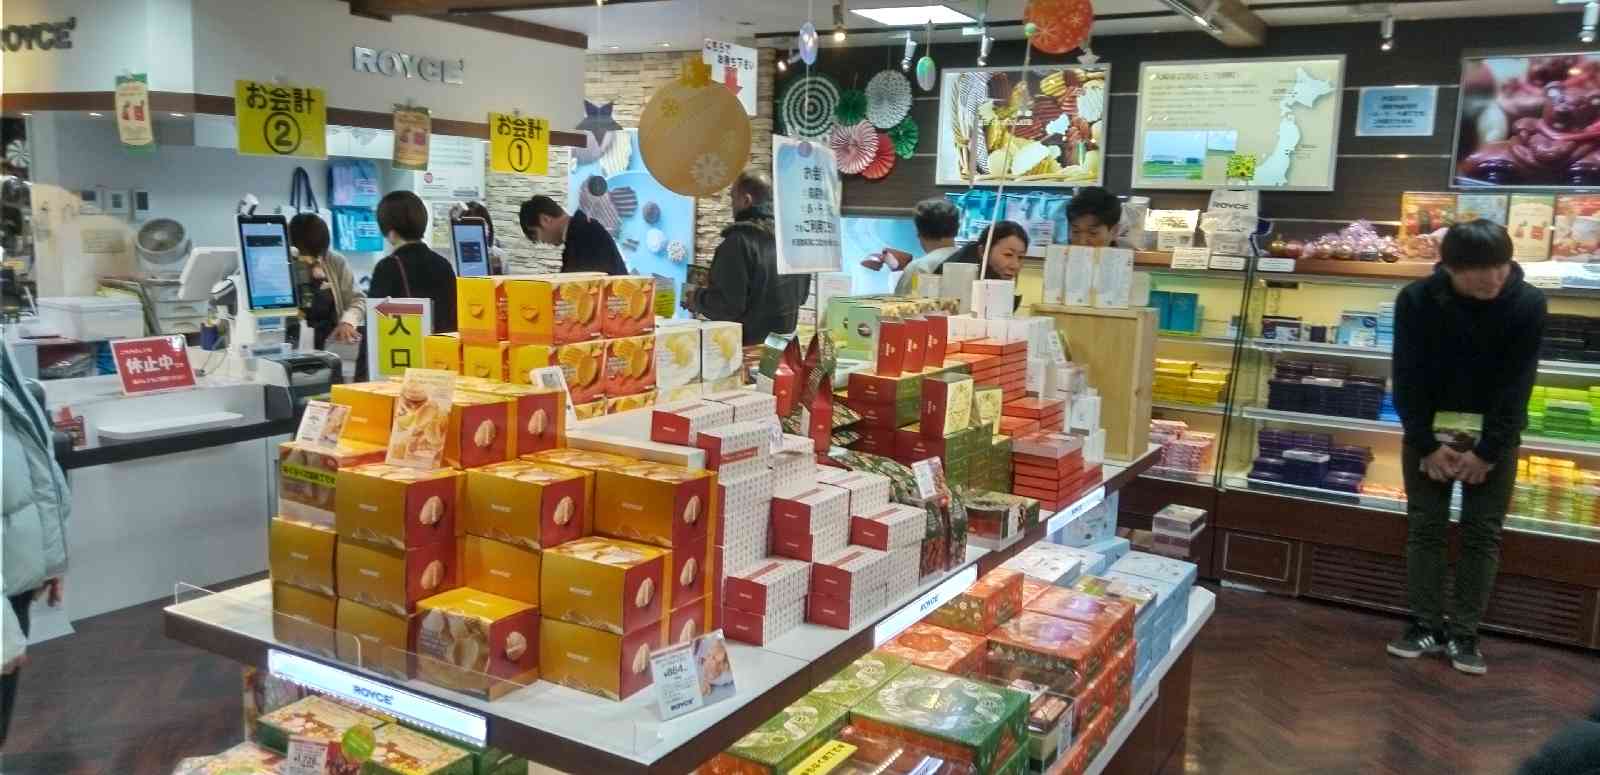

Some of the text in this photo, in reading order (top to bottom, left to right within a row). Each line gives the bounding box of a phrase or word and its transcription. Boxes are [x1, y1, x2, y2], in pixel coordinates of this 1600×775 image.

[246, 82, 315, 114] お会計
[497, 114, 543, 140] お会計
[388, 314, 411, 368] 入口
[126, 354, 174, 375] 休止中
